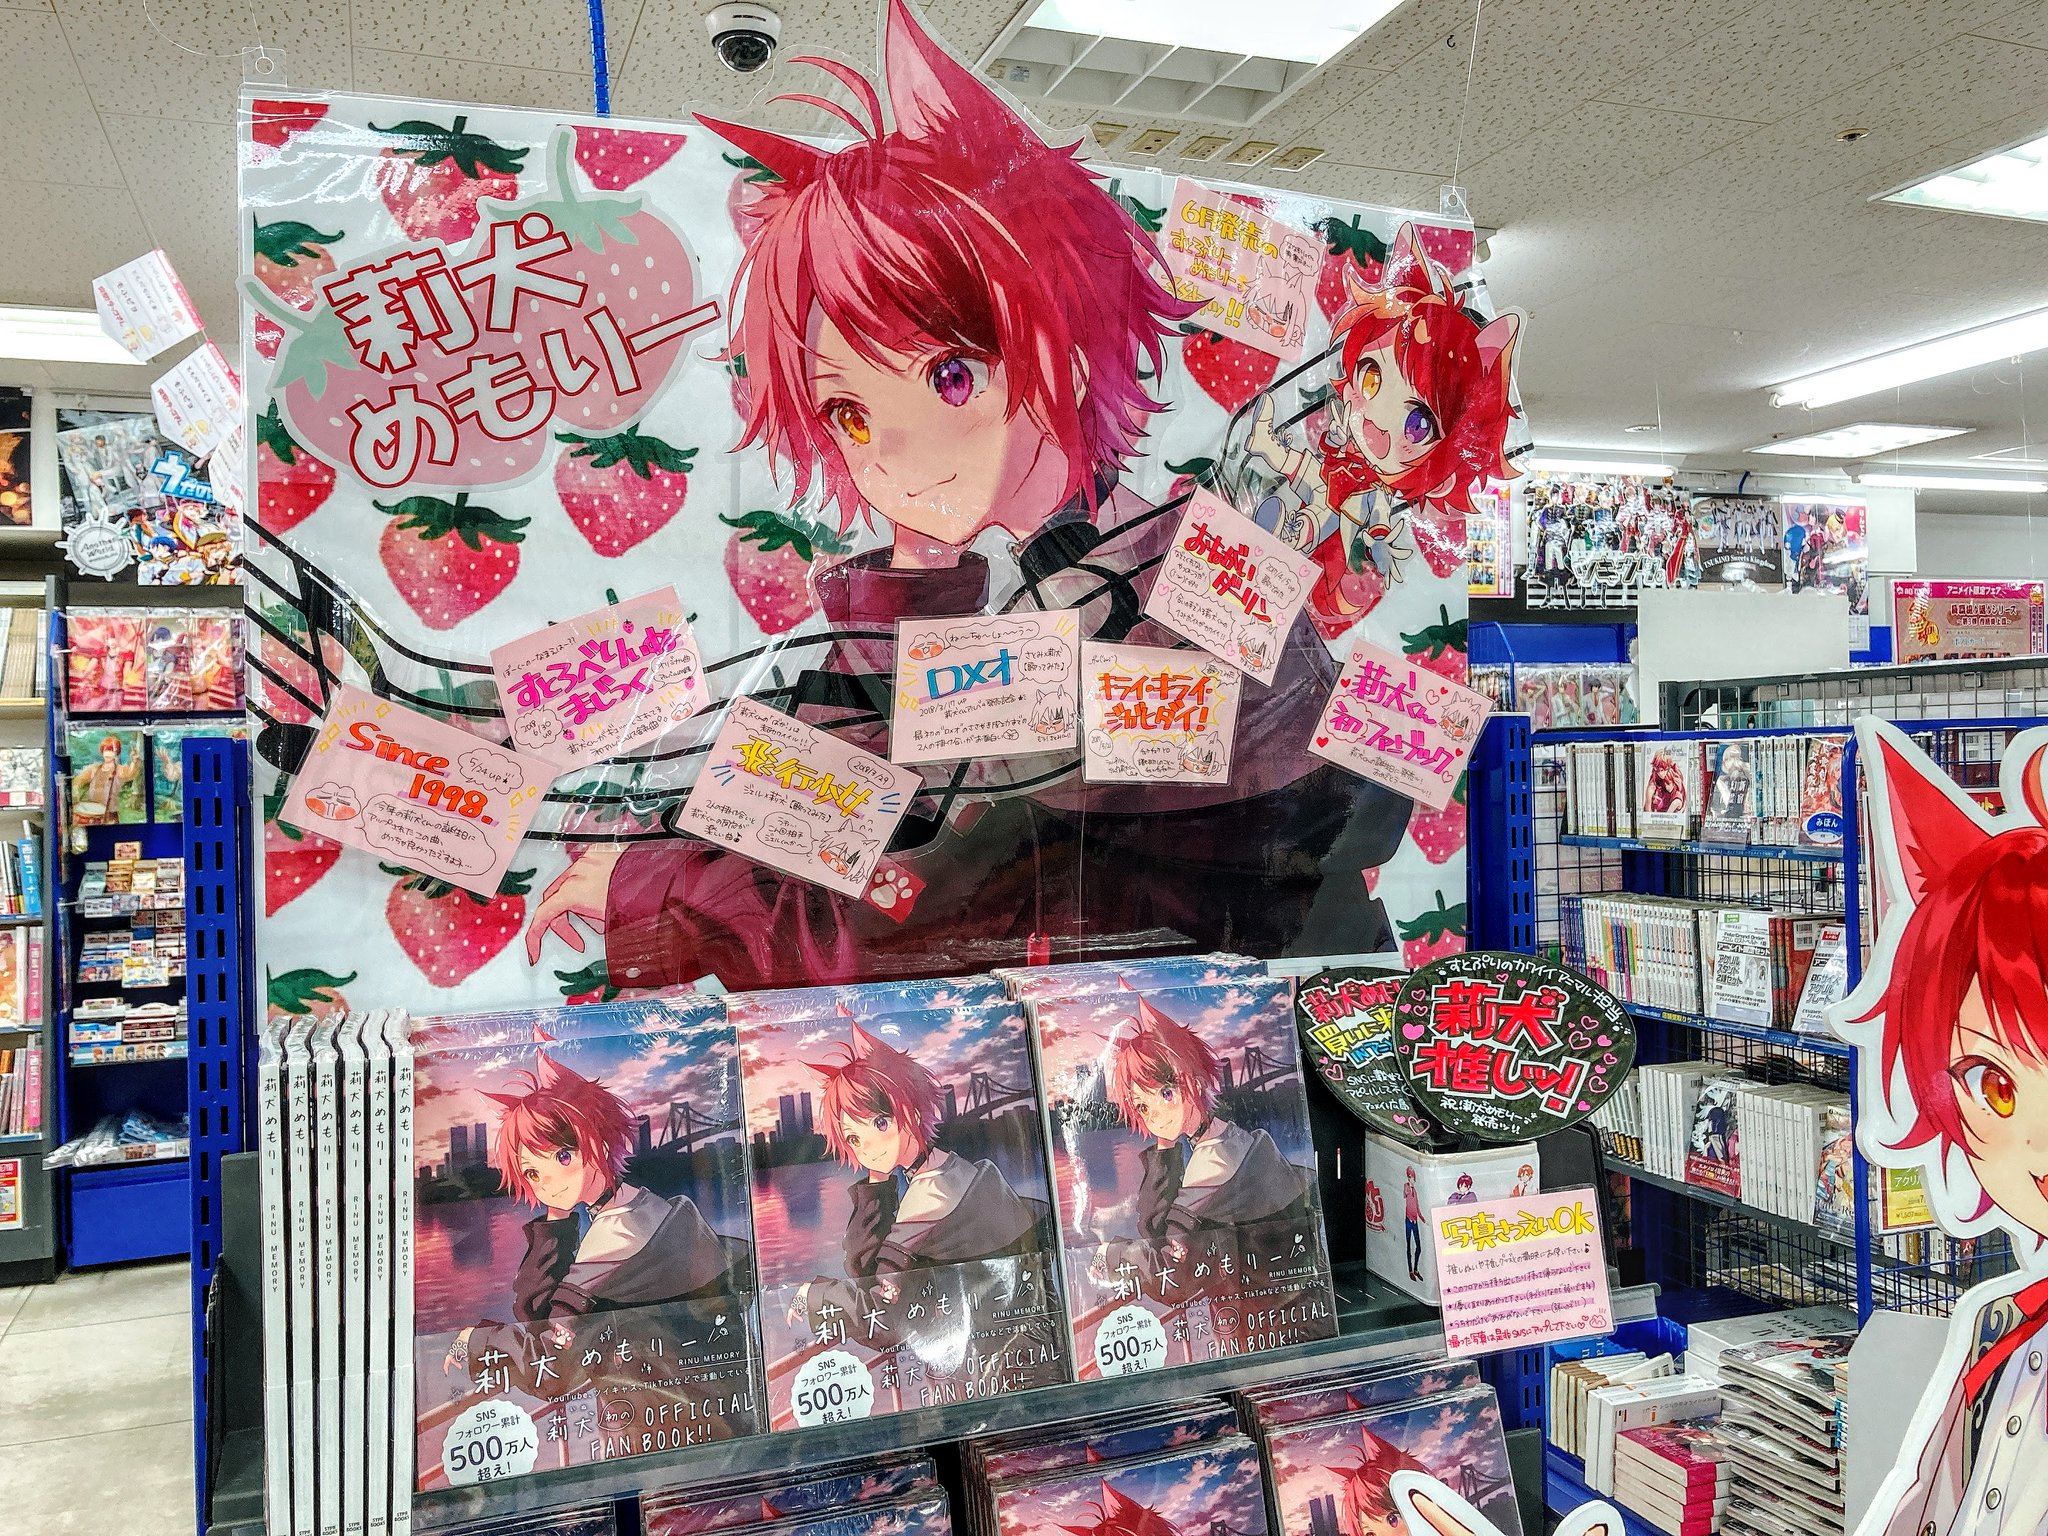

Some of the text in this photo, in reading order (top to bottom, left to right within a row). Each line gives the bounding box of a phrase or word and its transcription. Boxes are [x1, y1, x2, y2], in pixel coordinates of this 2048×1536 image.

[323, 211, 588, 374] 莉犬
[346, 300, 721, 489] めもりー
[1184, 523, 1258, 582] おねがい
[1212, 570, 1272, 624] ダーリン
[557, 667, 655, 725] まじっく
[1351, 660, 1437, 726] 莉犬くん
[345, 721, 450, 780] Since
[408, 773, 494, 826] 1998.
[732, 735, 874, 819] 飛行少女
[1815, 817, 1839, 828] みほん
[1448, 953, 1625, 1024] すとぷりのカワイイアニマル担当
[1434, 980, 1560, 1050] 莉犬
[1412, 1039, 1586, 1115] 推しッ!
[264, 1078, 277, 1176] 莉犬めもりー
[292, 1075, 306, 1172] 莉犬めもりー
[320, 1073, 333, 1171] 莉犬めもりー
[349, 1071, 362, 1168] 莉犬めもりー
[374, 1070, 387, 1166] 莉犬めもりー
[399, 1067, 412, 1163] 莉犬めもりー
[269, 1204, 278, 1293] RINU MEMORY
[1441, 1202, 1596, 1251] 写真さつえいOK
[298, 1241, 306, 1289] MEMORY
[352, 1236, 360, 1283] MEMORY
[401, 1230, 409, 1277] MEMORY
[1113, 1252, 1283, 1302] 莉犬めもりー
[1267, 1264, 1319, 1279] RINU MEMORY
[814, 1292, 1009, 1346] 莉犬めもりー
[991, 1303, 1046, 1320] RINU MEMORY
[1101, 1317, 1153, 1340] フォロワー累計
[1116, 1311, 1134, 1325] SNS
[1171, 1316, 1211, 1343] 莉犬
[1246, 1300, 1330, 1331] OFFICIAL
[473, 1337, 698, 1396] 莉犬めもりー
[677, 1350, 741, 1368] RINU MEMORY
[816, 1357, 836, 1371] SNS
[880, 1342, 1062, 1391] 莉犬 OFFICIAL
[1099, 1335, 1165, 1367] 500万人
[1120, 1356, 1149, 1375] 超え!
[1206, 1336, 1241, 1360] FAN
[800, 1363, 858, 1388] フォロワー累計
[920, 1382, 957, 1408] FAN
[474, 1408, 498, 1423] SNS
[546, 1392, 755, 1443] 莉犬 初の OFFICIAL
[797, 1383, 871, 1418] 500万人
[821, 1406, 853, 1426] 超え!
[454, 1413, 521, 1441] フォロワー累計
[590, 1436, 632, 1461] FAN
[449, 1436, 534, 1474] 500万人
[476, 1461, 512, 1482] 超え!
